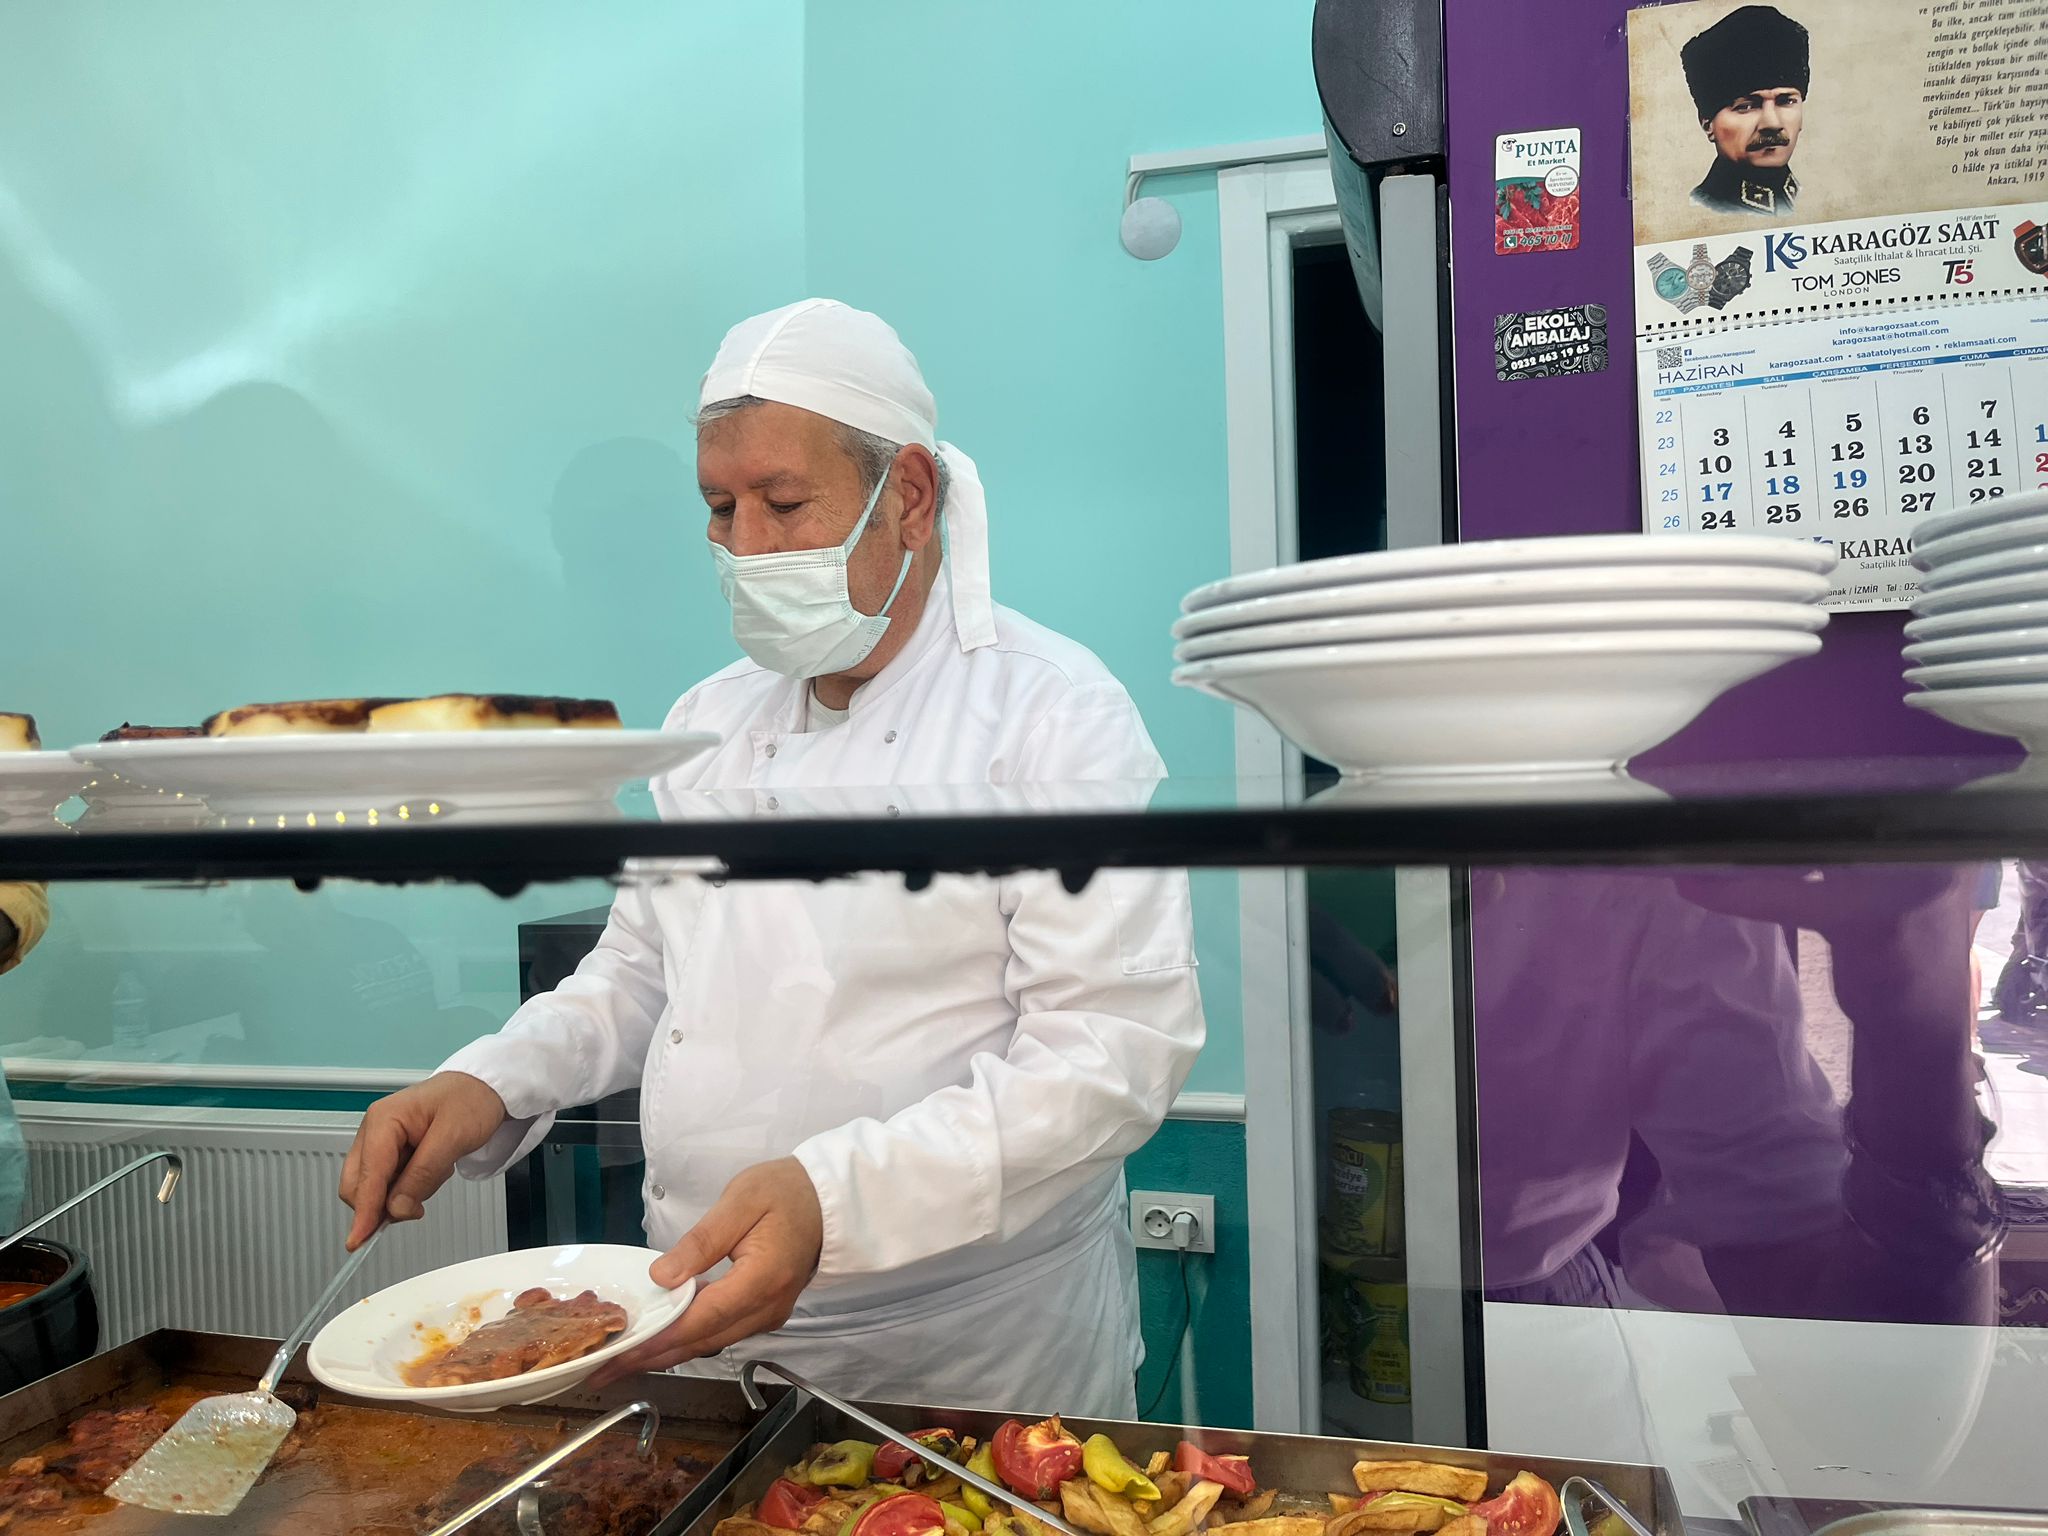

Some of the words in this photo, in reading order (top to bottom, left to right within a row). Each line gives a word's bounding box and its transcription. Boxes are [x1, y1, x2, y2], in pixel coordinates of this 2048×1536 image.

[1932, 1, 1958, 16] şerefli
[1932, 19, 1942, 28] Bu
[1969, 13, 1993, 24] ancak
[1934, 31, 1967, 43] olmakla
[1927, 47, 1954, 59] zengin
[1959, 46, 1968, 55] ve
[1972, 42, 1999, 54] bolluk
[2004, 39, 2029, 52] içinde
[1928, 60, 1972, 73] istiklalden
[1976, 57, 2005, 70] yoksun
[2010, 55, 2022, 64] bir
[1923, 76, 1956, 88] insanlık
[1960, 74, 1992, 86] dünyası
[1997, 68, 2040, 81] karşısında
[1923, 90, 1970, 102] mevkiinden
[1975, 86, 2004, 100] yüksek
[2008, 84, 2021, 94] bir
[1928, 106, 1980, 119] görülemez...
[1983, 100, 2015, 112] Türk'ün
[1929, 124, 1938, 132] ve
[1943, 118, 1982, 131] kabiliyeti
[1986, 116, 2001, 128] çok
[2005, 113, 2035, 127] yüksek
[1936, 136, 1959, 148] Böyle
[1963, 132, 1976, 143] bir
[1980, 130, 2004, 142] millet
[2009, 128, 2025, 139] esir
[1516, 140, 1578, 158] PUNTA
[1964, 148, 1979, 160] yok
[1984, 147, 2006, 156] olsun
[2011, 144, 2032, 154] daha
[1528, 159, 1536, 167] Et
[1538, 158, 1566, 166] Market
[1952, 164, 1958, 174] O
[1963, 162, 1985, 173] hâlde
[1990, 163, 2000, 174] ya
[2004, 158, 2033, 170] istiklal
[2038, 158, 2048, 169] ya
[1987, 176, 2019, 186] Ankara,
[2024, 172, 2045, 183] 1919
[1520, 235, 1542, 246] 465
[1545, 234, 1558, 245] 10
[1812, 223, 1931, 255] KARAGÖZ
[1938, 220, 2000, 243] SAAT
[1764, 232, 1807, 272] KS
[1834, 254, 1872, 266] Saatçilik
[1874, 250, 1903, 262] İthalat
[1906, 250, 1914, 258] &
[1915, 247, 1948, 258] İhracat
[1949, 245, 1966, 255] Ltd.
[1968, 244, 1982, 255] Şti.
[1792, 274, 1834, 292] TOM
[1842, 268, 1901, 287] JONES
[1824, 287, 1870, 297] LONDON
[1525, 313, 1575, 331] EKOL
[1839, 318, 1940, 336] info@karagozsaat.com
[1511, 326, 1590, 348] AMBALAJ
[1832, 327, 1950, 346] karagozsaat@hotmail.com
[1511, 357, 1537, 370] 0232
[1539, 352, 1558, 364] 463
[1561, 348, 1574, 358] 19
[1576, 344, 1590, 354] 65
[1769, 355, 1844, 370] karagozsaat.com
[1856, 344, 1931, 359] saatatolyesi.com
[1944, 335, 2017, 350] reklamsaati.com
[1960, 353, 1990, 361] CUMA
[1659, 363, 1744, 384] HAZİRAN
[1656, 411, 1673, 424] 22
[1658, 437, 1675, 450] 23
[1714, 428, 1730, 446] 3
[1779, 421, 1796, 438] 4
[1846, 413, 1862, 432] 5
[1913, 406, 1930, 425] 6
[1980, 400, 1998, 419] 7
[1660, 463, 1676, 476] 24
[1699, 455, 1732, 475] 10
[1764, 449, 1796, 468] 11
[1831, 441, 1865, 462] 12
[1899, 434, 1933, 455] 13
[1967, 429, 2002, 449] 14
[1662, 489, 1678, 502] 25
[1701, 482, 1733, 502] 17
[1766, 475, 1801, 496] 18
[1833, 469, 1868, 490] 19
[1899, 463, 1936, 484] 20
[1968, 458, 2002, 479] 21
[1663, 516, 1680, 529] 26
[1701, 510, 1736, 530] 24
[1766, 504, 1802, 524] 25
[1834, 498, 1869, 519] 26
[1901, 492, 1936, 514] 27
[1860, 560, 1896, 570] Saatçilik
[1854, 584, 1879, 594] İZMİR
[1887, 584, 1897, 592] Tel
